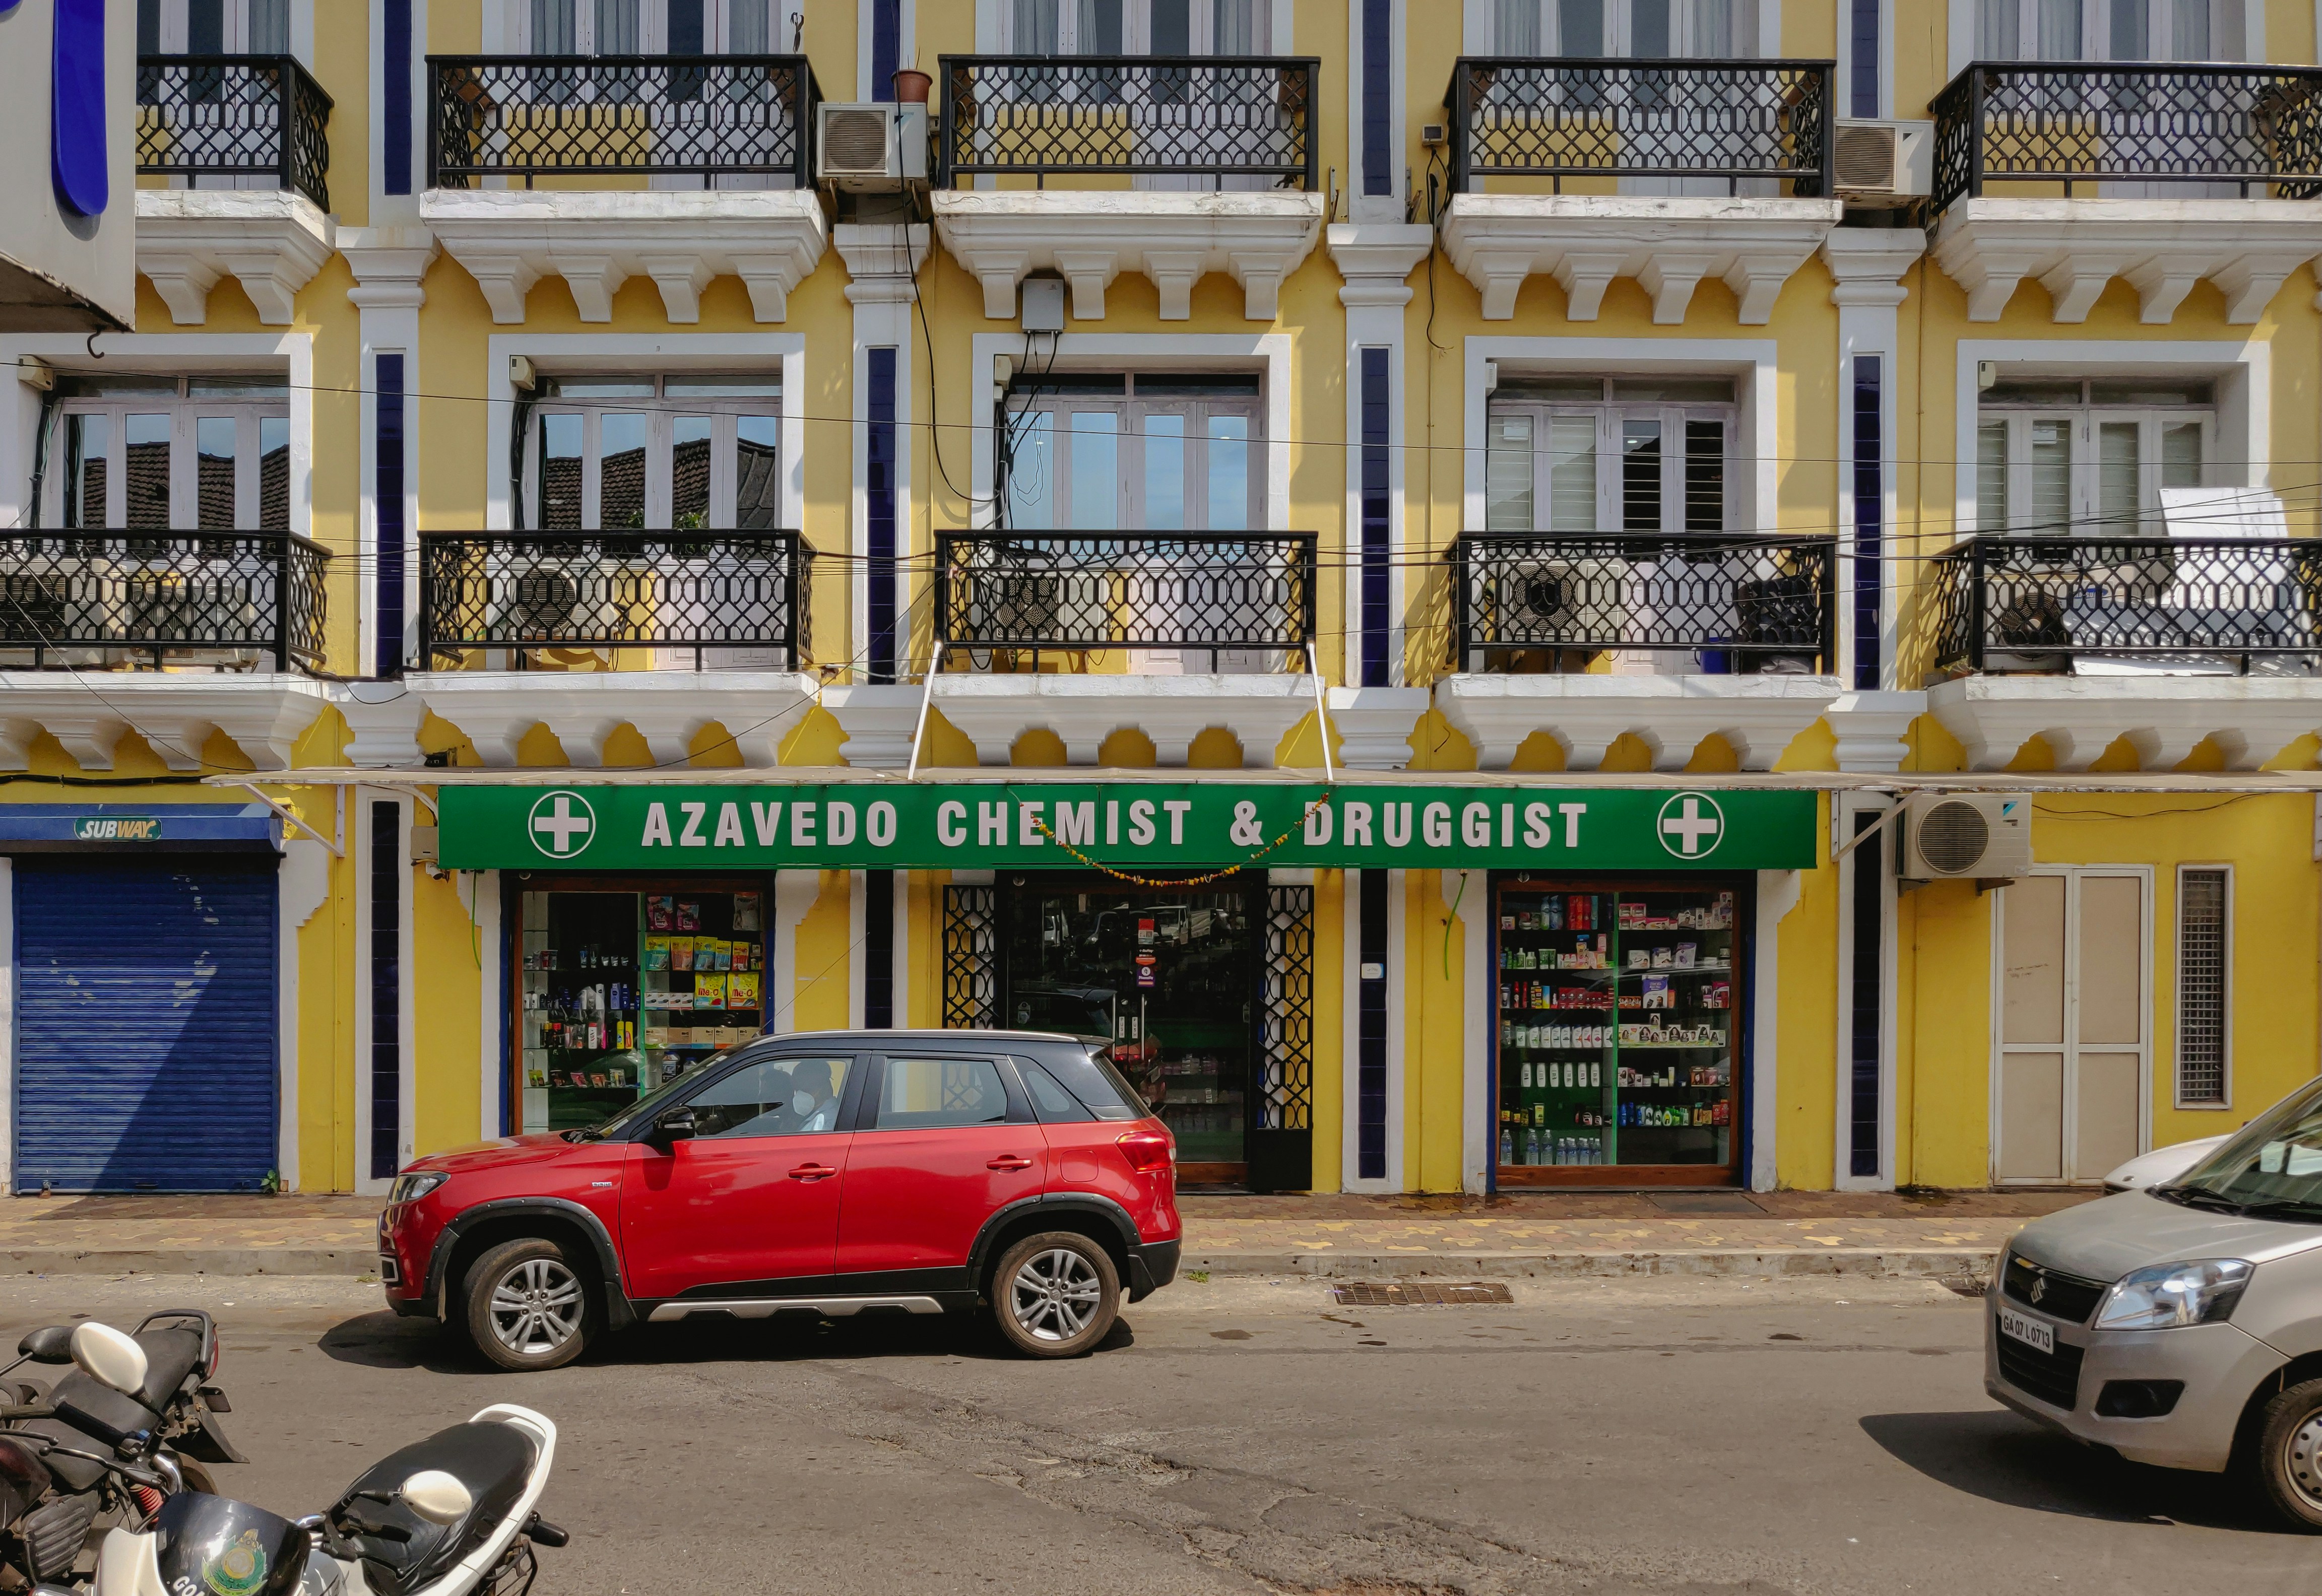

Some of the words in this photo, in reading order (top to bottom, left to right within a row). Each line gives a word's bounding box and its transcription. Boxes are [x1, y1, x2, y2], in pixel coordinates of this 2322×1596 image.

[80, 820, 156, 838] SUBWAY
[642, 802, 896, 846] AZAVEDO
[938, 801, 1190, 846] CHEMIST
[1230, 801, 1263, 846] &
[1305, 802, 1586, 847] DRUGGIST
[2004, 1315, 2014, 1333] GA
[2016, 1319, 2024, 1336] 07
[2025, 1323, 2030, 1340] L
[2031, 1326, 2050, 1349] 0713
[173, 1576, 205, 1596] GO
